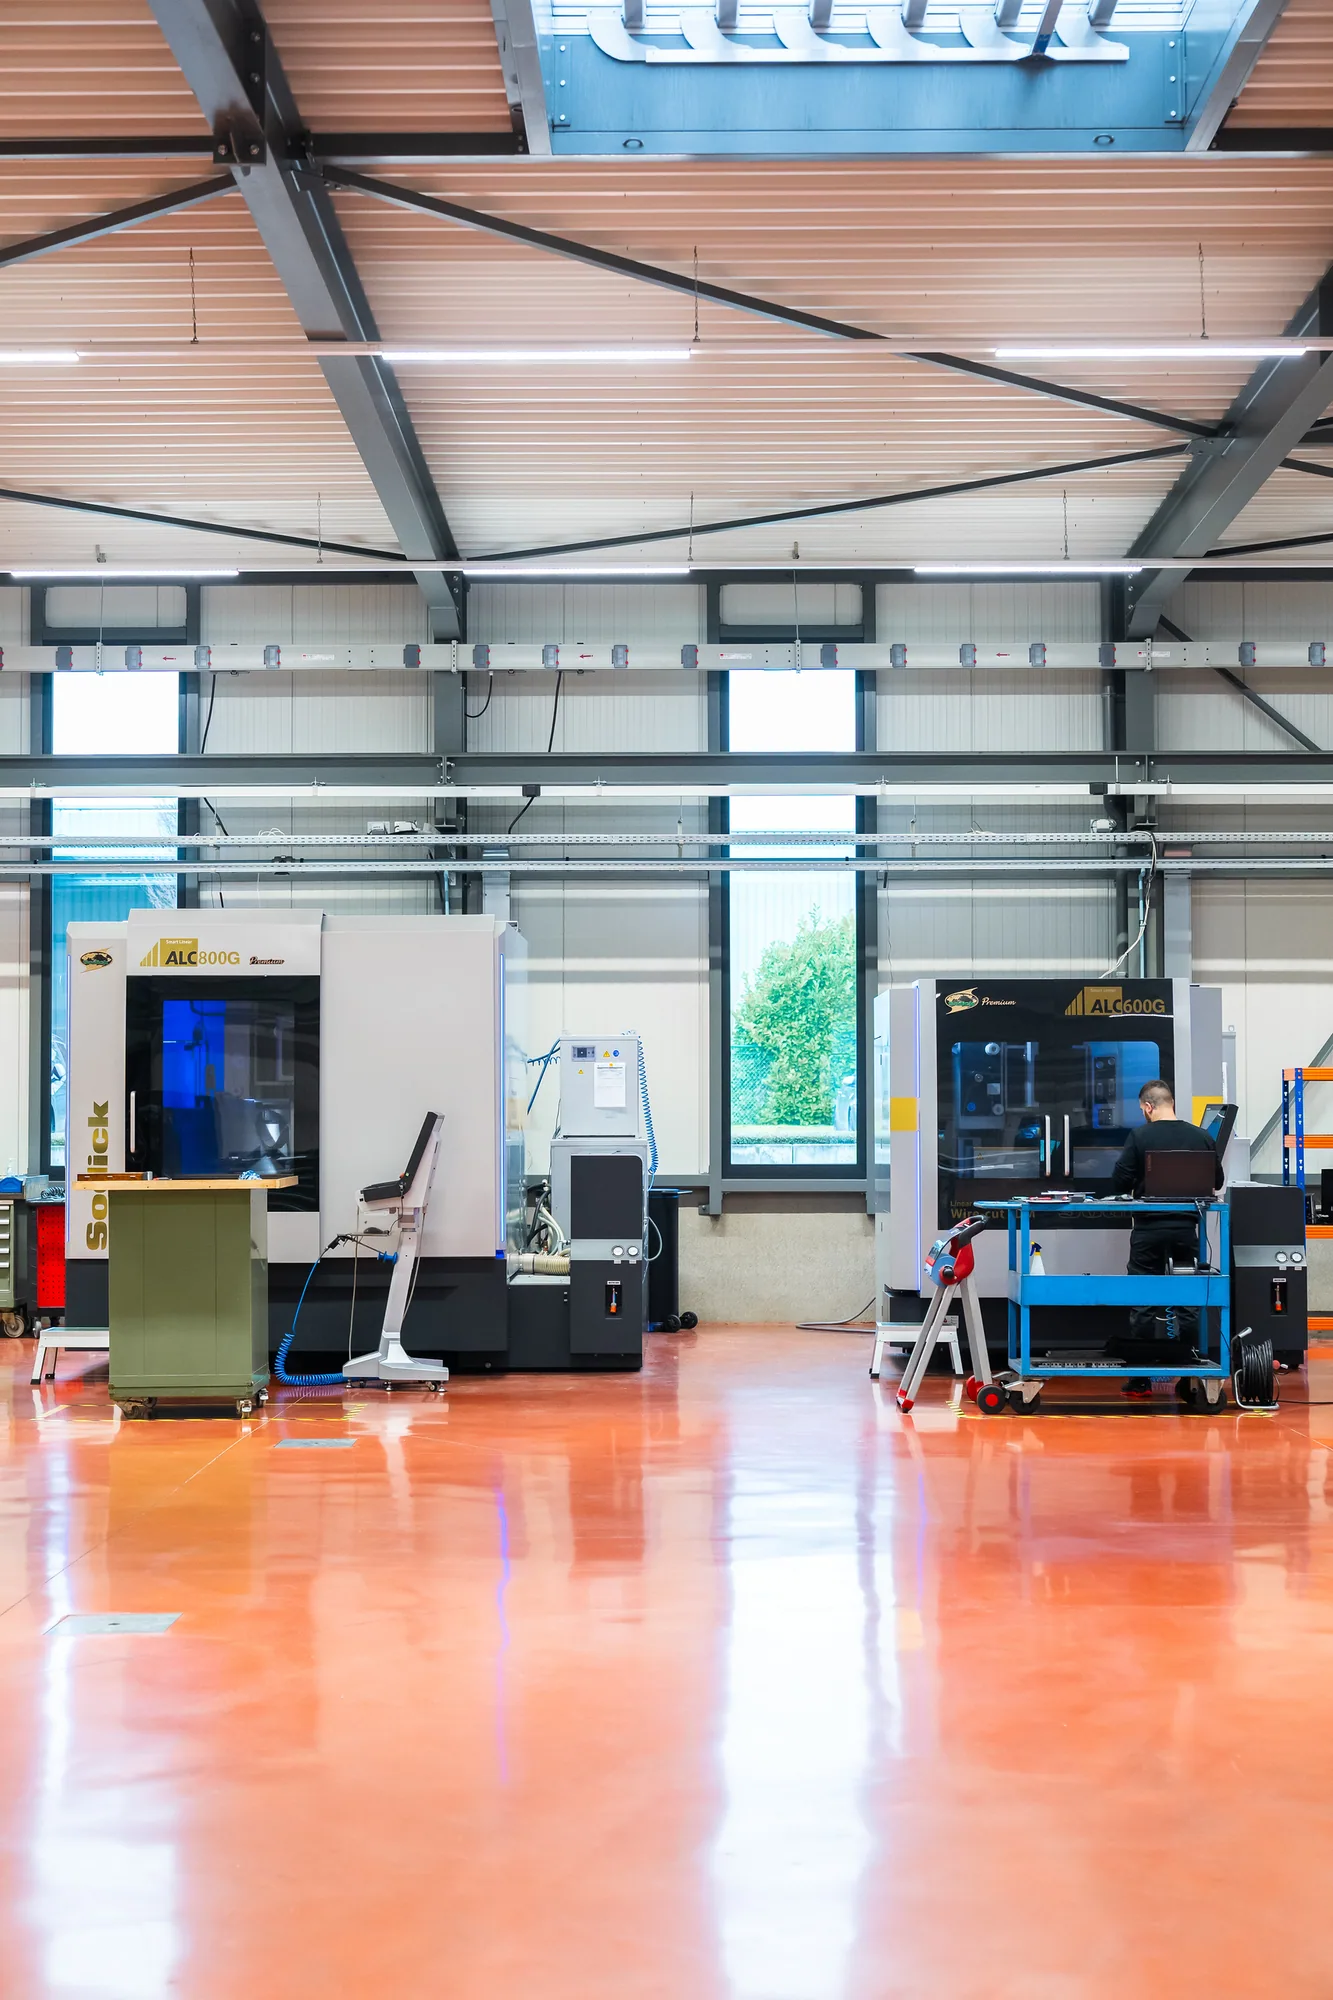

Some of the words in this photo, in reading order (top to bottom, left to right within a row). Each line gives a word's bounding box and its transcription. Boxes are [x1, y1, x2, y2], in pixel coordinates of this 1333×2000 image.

[165, 950, 240, 965] ALC800G
[249, 956, 285, 966] Premium
[981, 996, 1016, 1006] Premium
[1090, 998, 1165, 1014] ALC600G
[86, 1100, 108, 1250] Soick
[951, 1208, 1004, 1219] Wirecut
